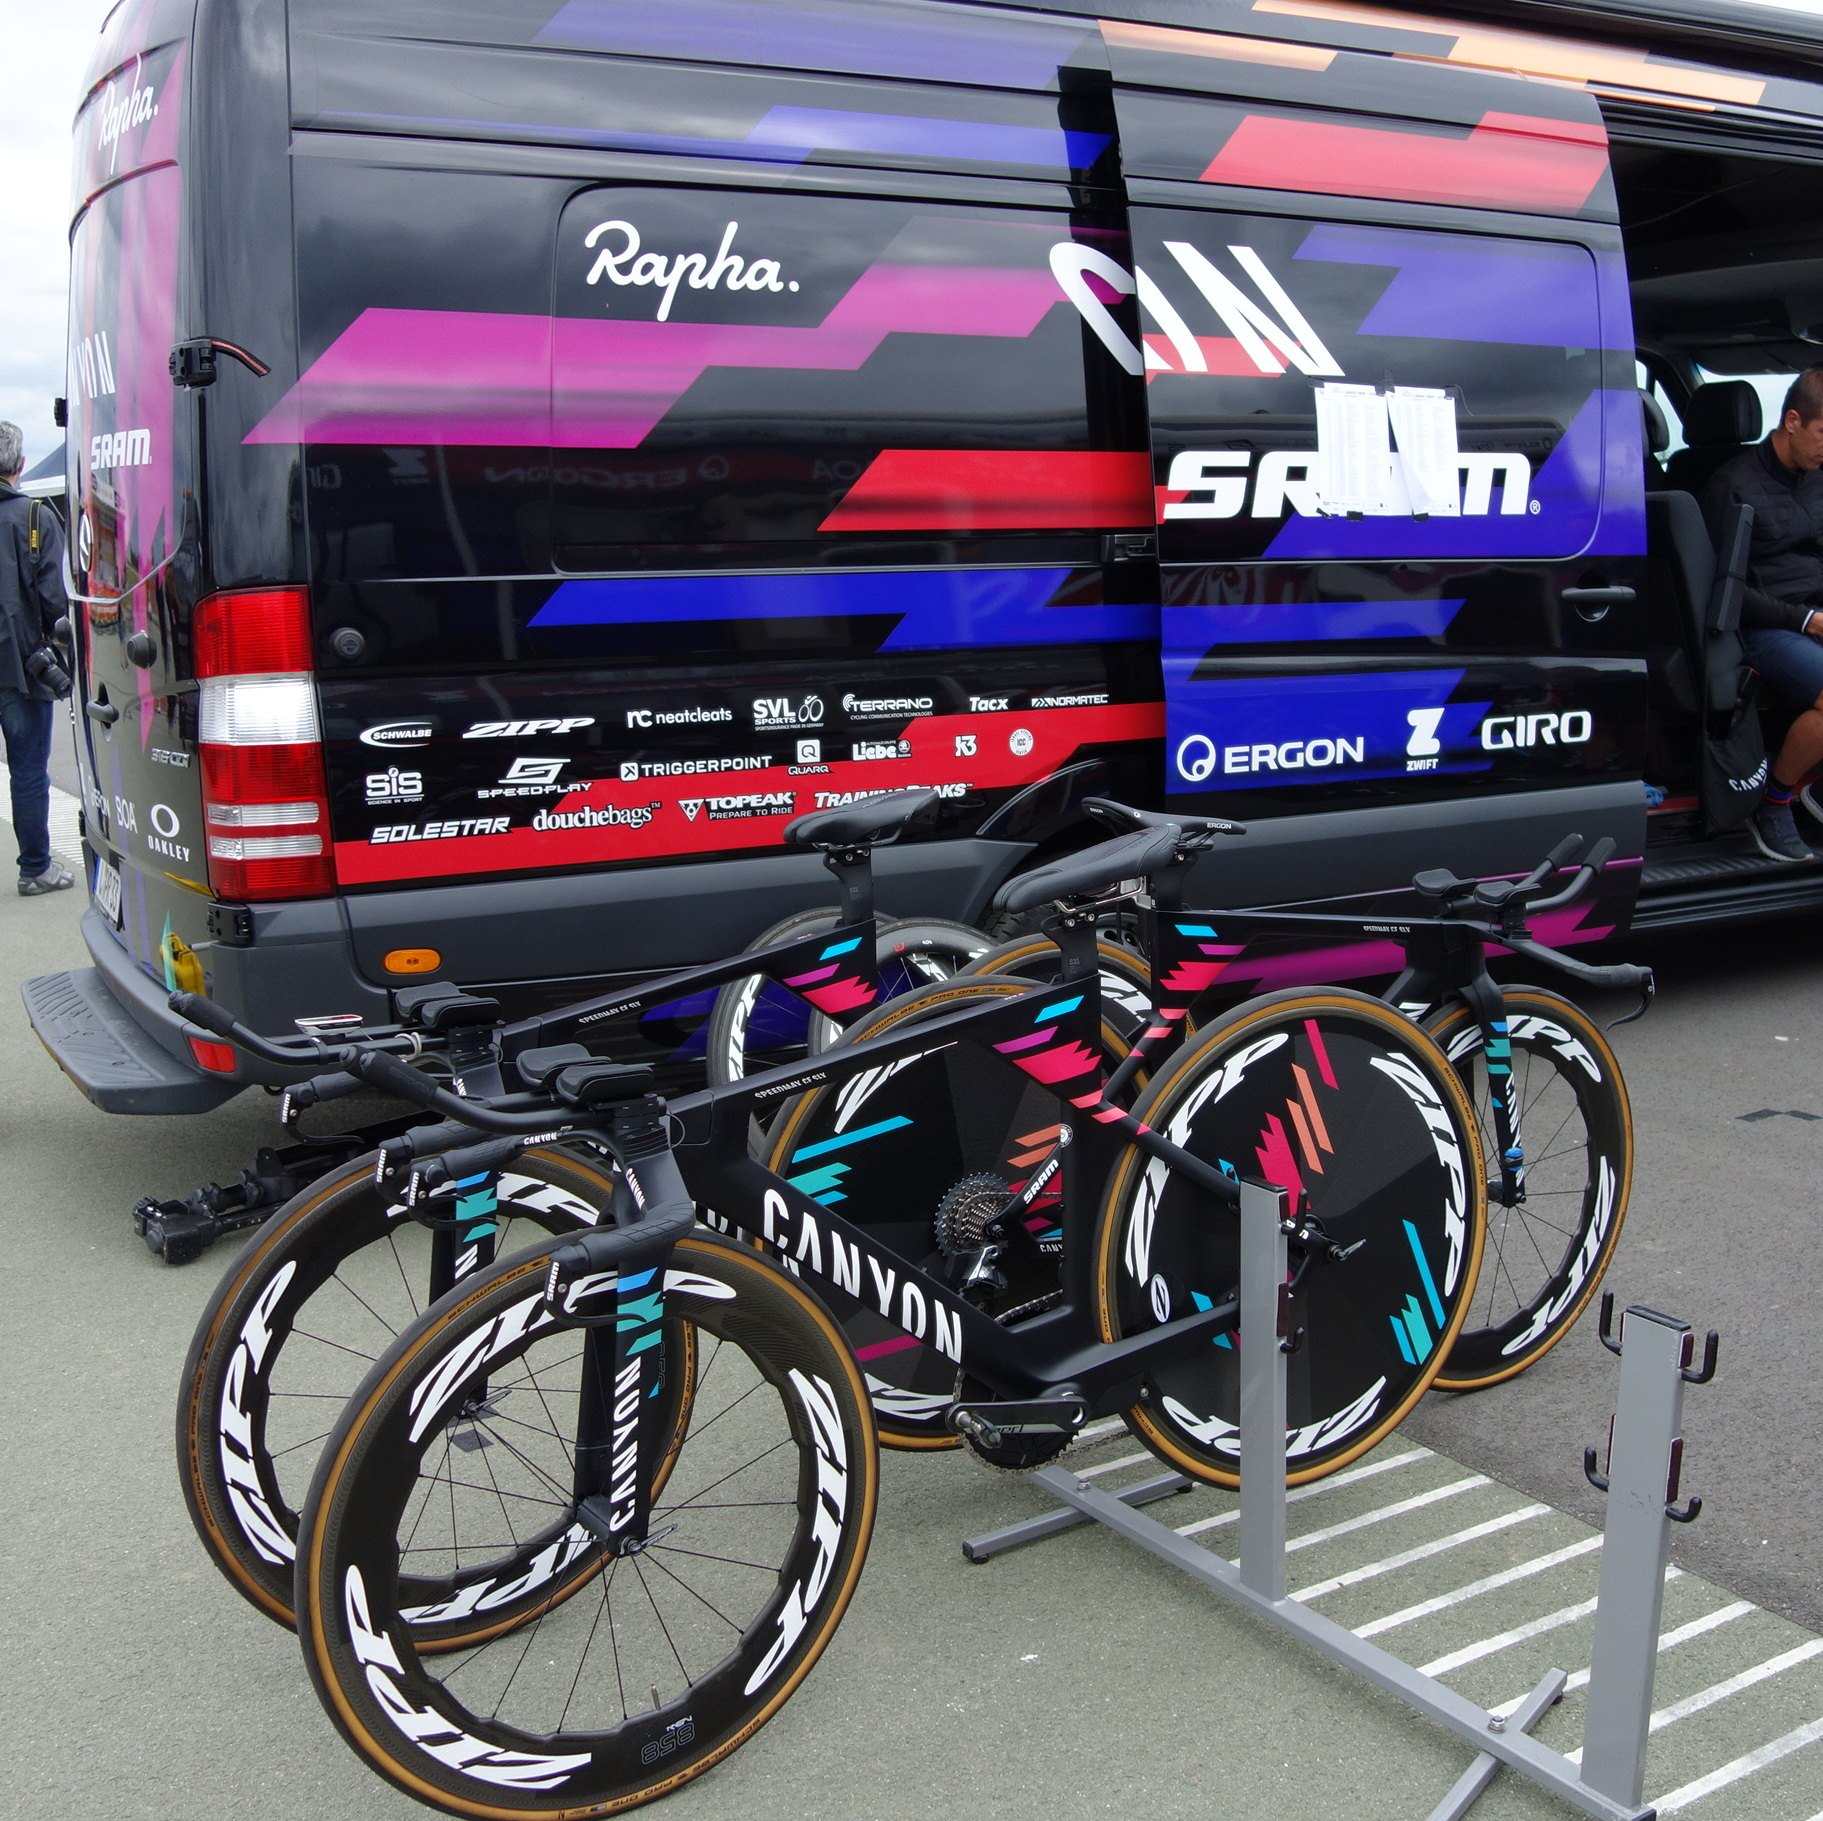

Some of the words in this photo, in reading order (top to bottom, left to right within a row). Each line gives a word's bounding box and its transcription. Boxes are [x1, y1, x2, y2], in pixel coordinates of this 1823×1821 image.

[584, 220, 800, 322] Rapha.
[91, 429, 151, 470] SRAM
[1163, 450, 1531, 519] SRM
[655, 707, 733, 725] neatcleats
[753, 698, 797, 719] SVL
[849, 697, 934, 712] TERRANO
[969, 697, 1009, 712] Tacx
[372, 727, 433, 741] SCHWALBE
[462, 717, 596, 739] ZIPP
[754, 717, 797, 726] SPORTS
[1481, 710, 1592, 751] GIRO
[852, 741, 897, 761] Liebe
[1223, 736, 1365, 774] ERGON
[641, 755, 773, 778] TRIGGERPOINT
[788, 764, 830, 776] QUARQ
[1406, 758, 1439, 773] ZWIFT
[477, 782, 593, 799] SPEEDPLAY
[705, 792, 794, 811] TOPEAK
[532, 803, 653, 831] douchebags
[709, 810, 752, 820] PREPARE
[756, 808, 769, 816] TO
[771, 806, 793, 815] RIDE
[370, 816, 511, 844] SOLESTAR
[1206, 822, 1233, 830] ERGON
[147, 835, 191, 863] OAKLEY
[1023, 1158, 1060, 1205] SRAM
[1371, 1052, 1468, 1297] ZIPP
[545, 1261, 561, 1301] SRAM
[762, 1187, 964, 1365] CANYON
[608, 1355, 642, 1532] CANYON
[743, 1368, 848, 1697] ZIPP
[344, 1564, 593, 1790] ZIPP
